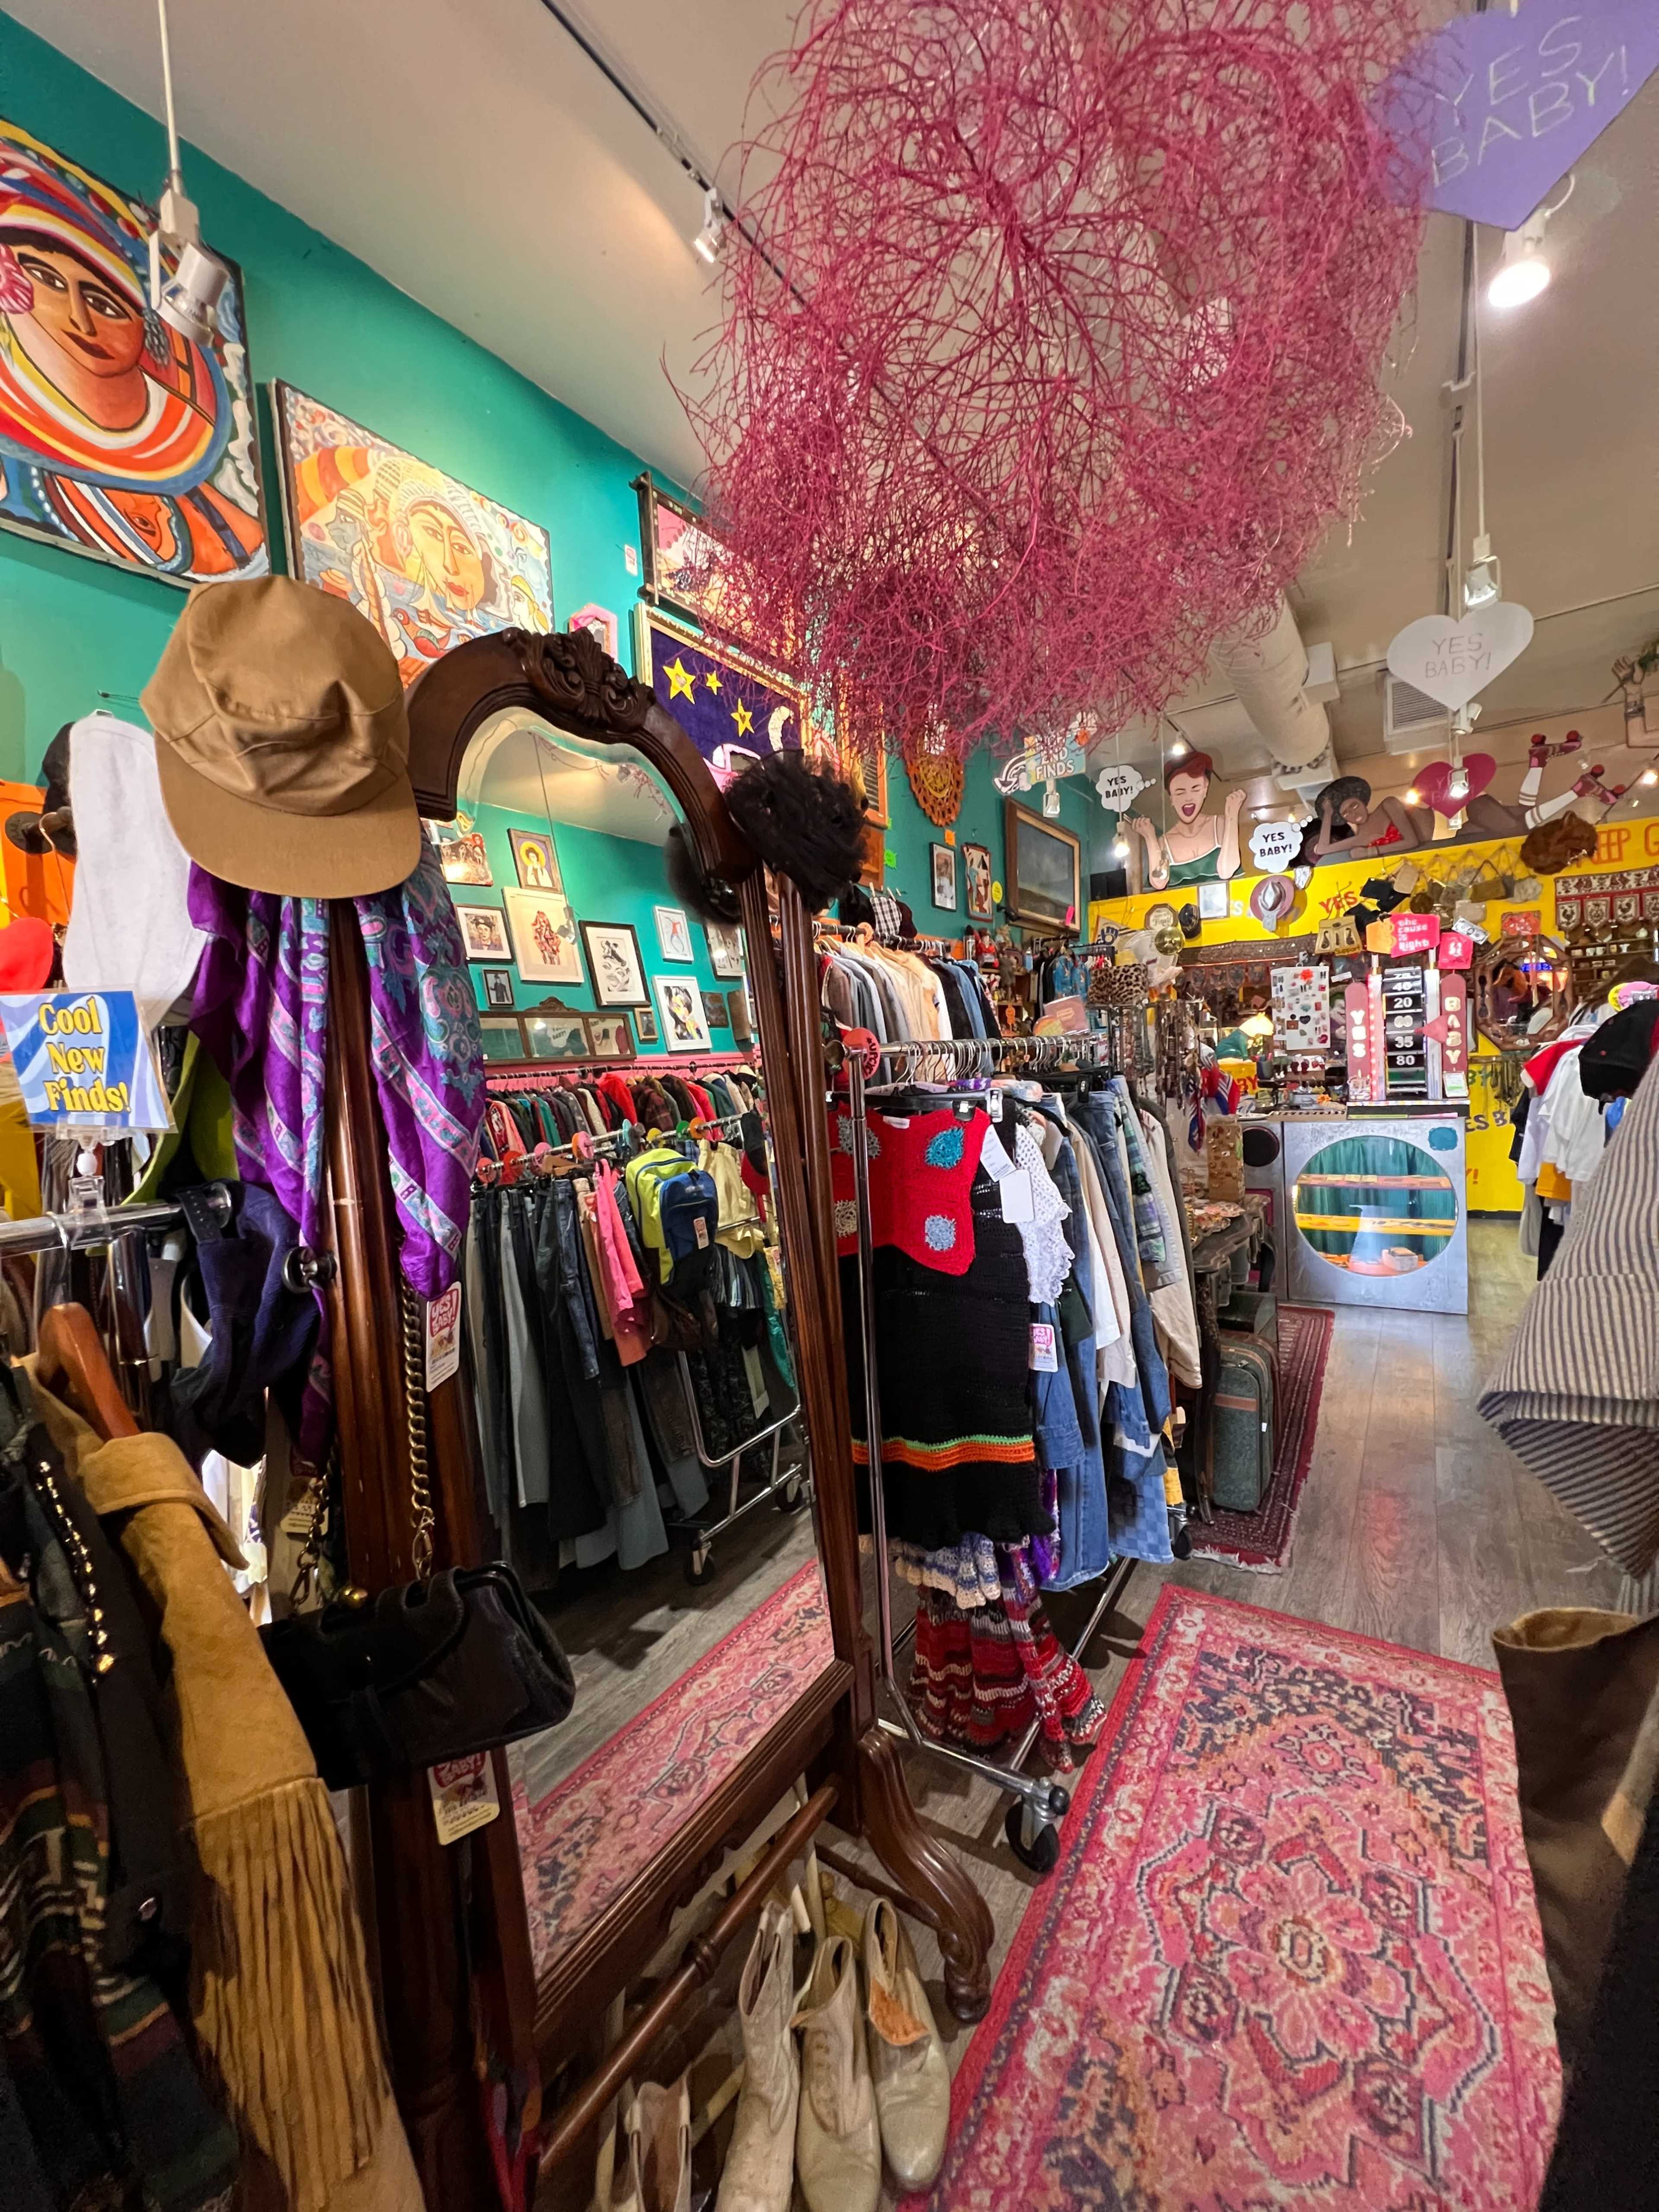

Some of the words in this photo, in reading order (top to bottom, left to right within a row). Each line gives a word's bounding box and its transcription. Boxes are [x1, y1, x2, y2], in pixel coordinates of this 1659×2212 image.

[1435, 16, 1583, 127] YES
[1431, 44, 1630, 188] BABY!
[1432, 632, 1483, 655] YES
[1425, 651, 1491, 678] BABY!
[1036, 759, 1075, 781] FINDS
[1105, 786, 1133, 798] BABY!
[1107, 776, 1127, 787] YES
[1262, 832, 1285, 843] YES
[1260, 844, 1292, 857] BABY!
[1319, 891, 1357, 913] YES
[1392, 981, 1413, 991] 40
[1394, 997, 1413, 1008] 20
[38, 996, 103, 1036] Cool
[1395, 1036, 1414, 1048] 35
[45, 1042, 105, 1074] New
[1396, 1055, 1415, 1065] 80
[43, 1076, 131, 1113] Finds!
[432, 1294, 451, 1315] YES
